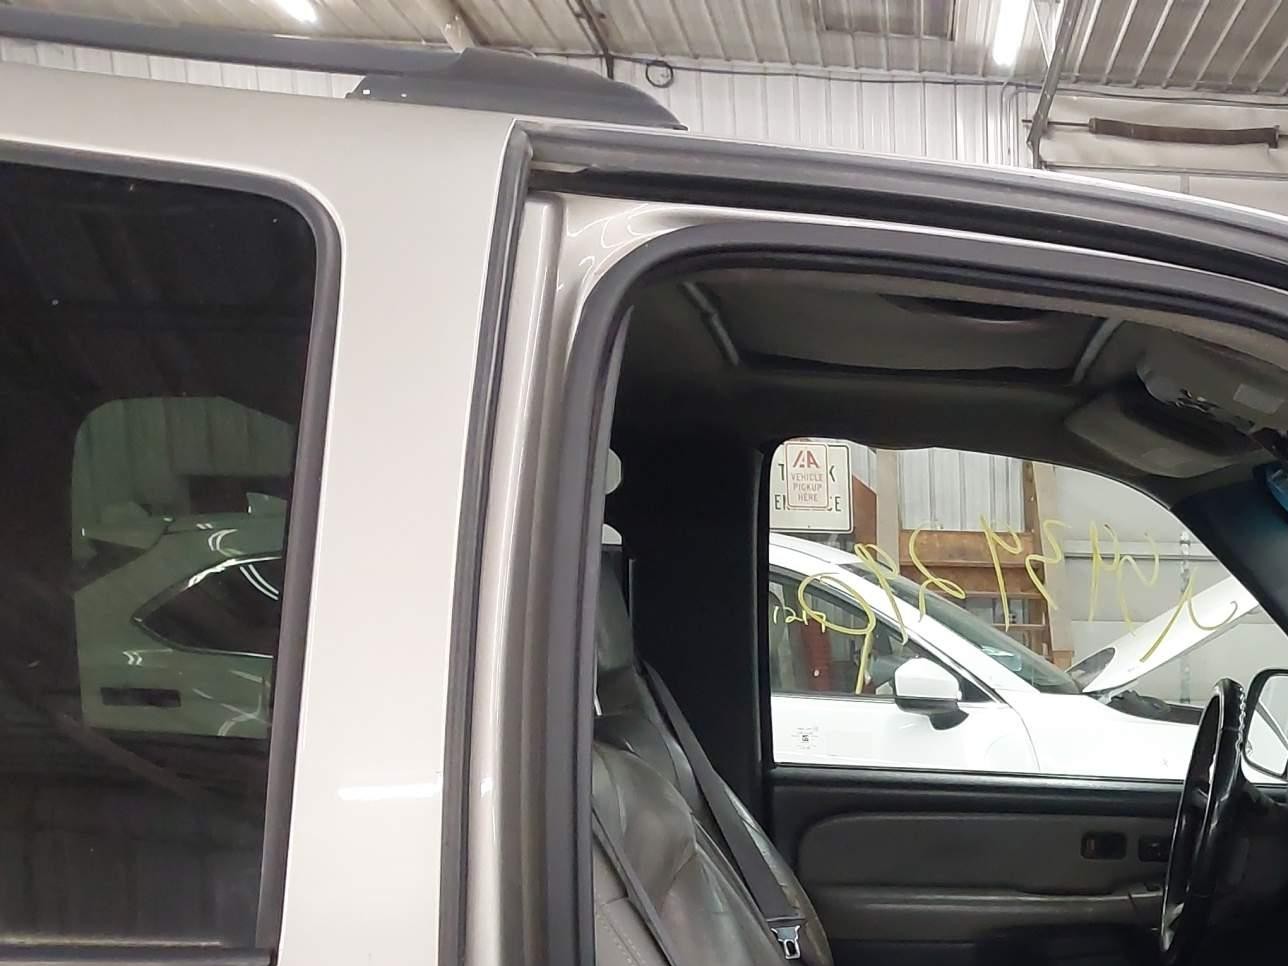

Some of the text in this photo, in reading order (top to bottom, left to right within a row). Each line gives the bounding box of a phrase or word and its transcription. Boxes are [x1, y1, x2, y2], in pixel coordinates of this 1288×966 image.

[790, 472, 824, 482] VEHICLE
[792, 482, 823, 492] PICKUP
[797, 493, 818, 502] HERE
